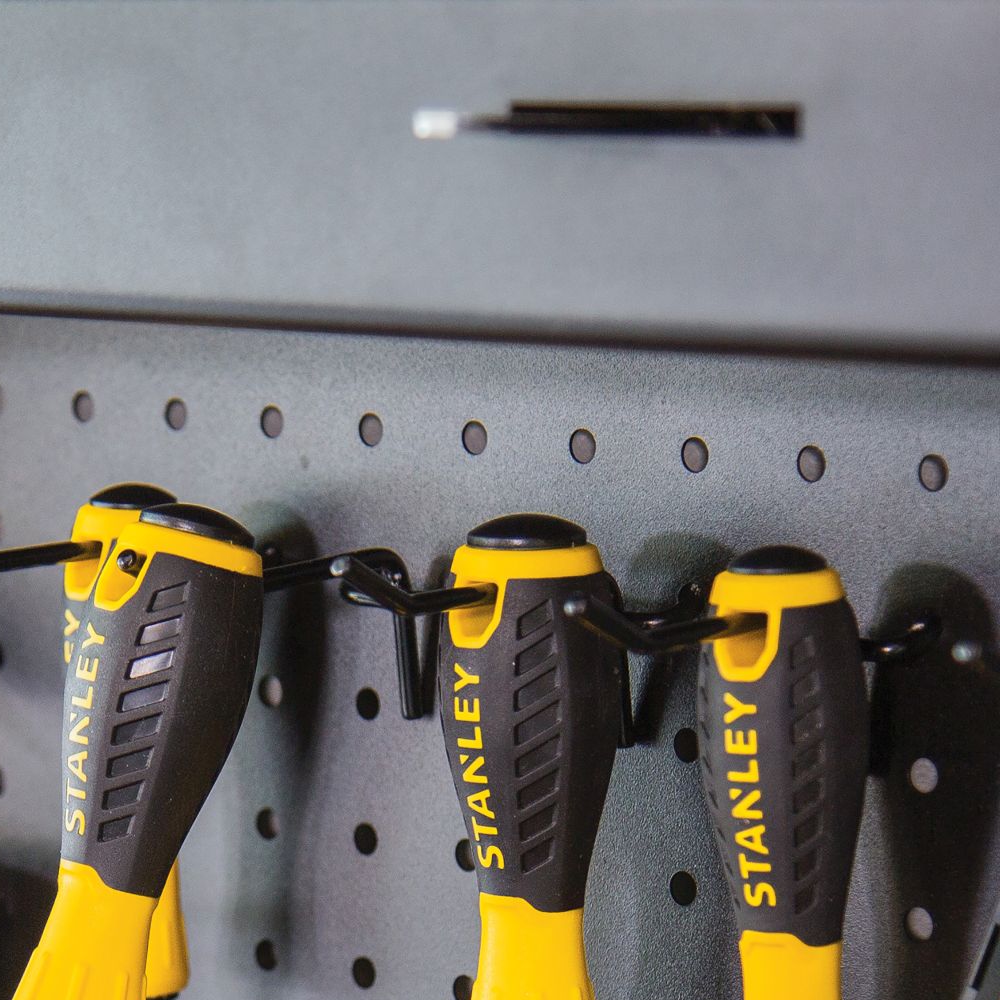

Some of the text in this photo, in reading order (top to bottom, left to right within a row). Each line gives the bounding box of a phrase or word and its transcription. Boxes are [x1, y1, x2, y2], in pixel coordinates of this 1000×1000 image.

[65, 622, 106, 836] STANLEY
[453, 662, 505, 870] STANLEY
[723, 692, 777, 907] STANLEY
